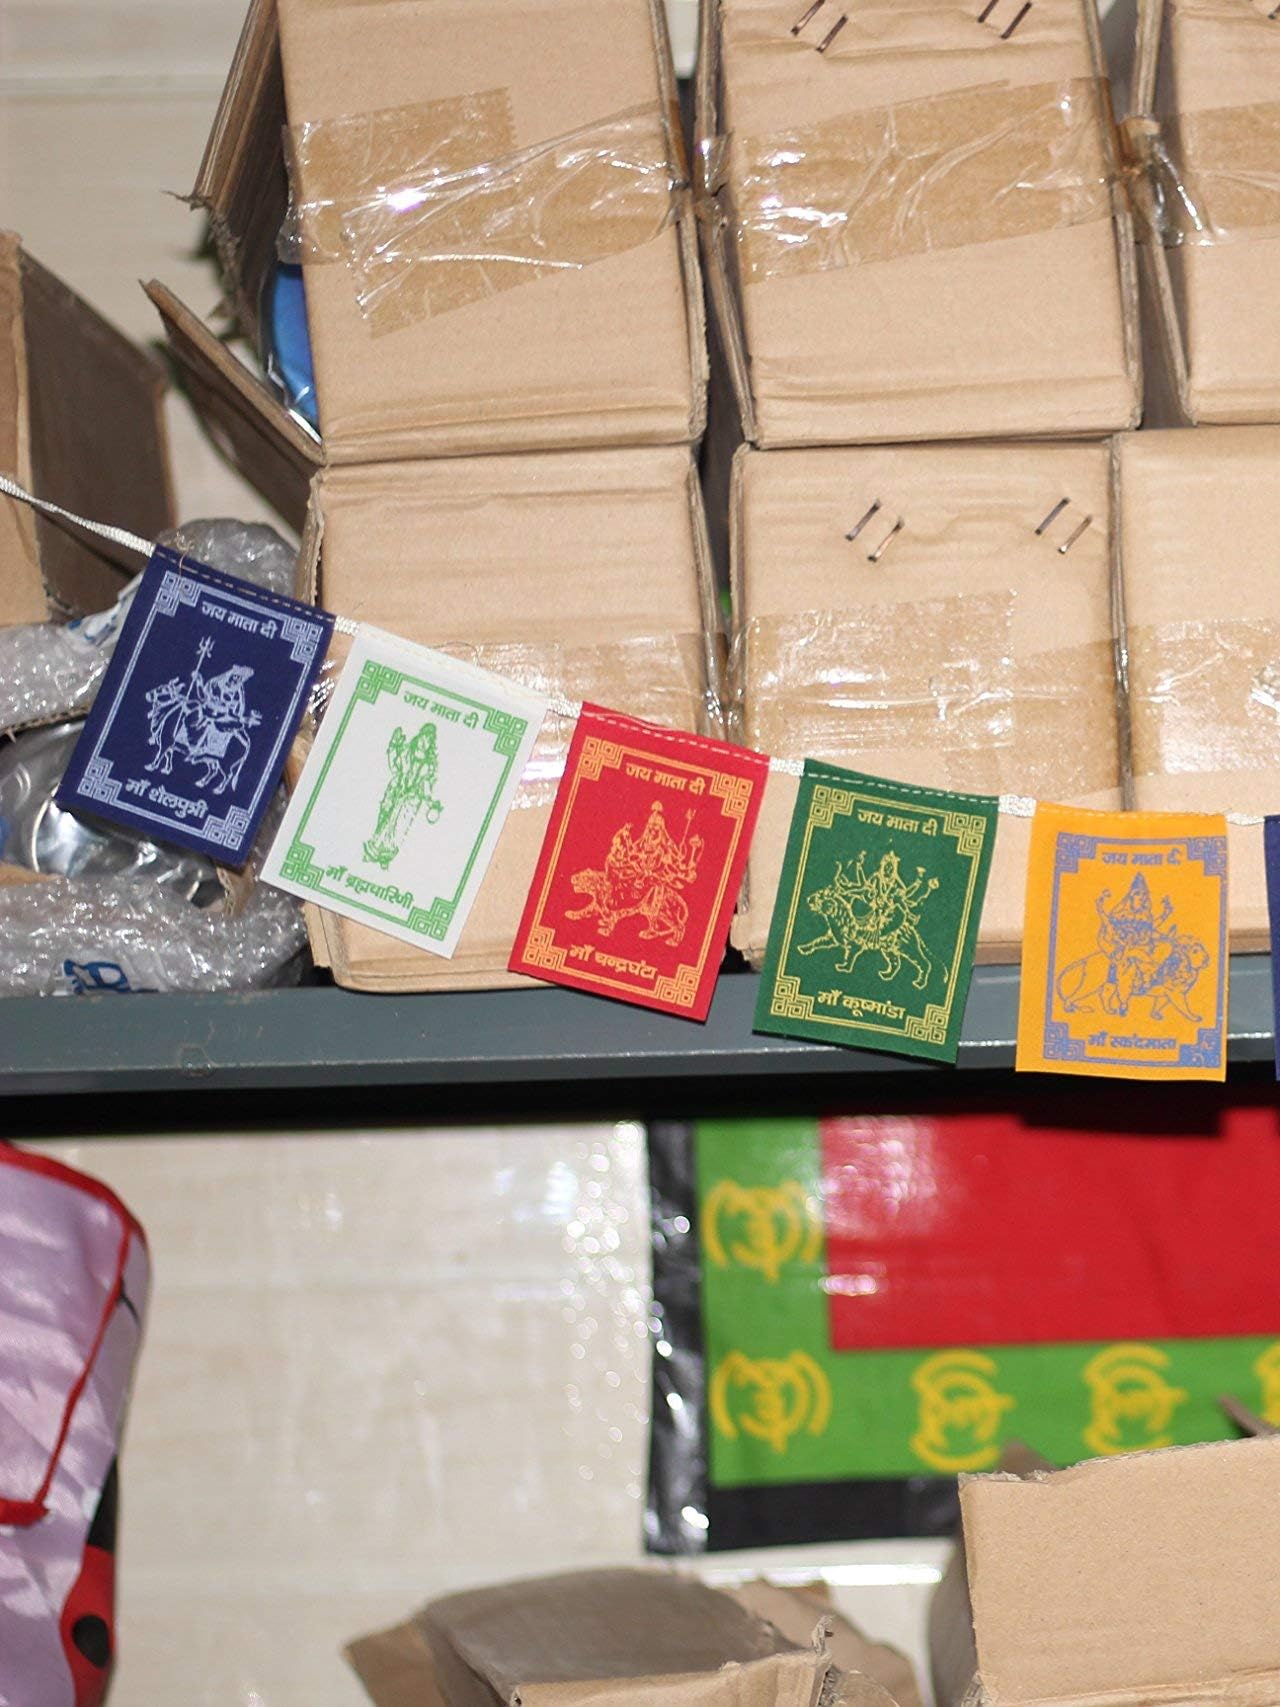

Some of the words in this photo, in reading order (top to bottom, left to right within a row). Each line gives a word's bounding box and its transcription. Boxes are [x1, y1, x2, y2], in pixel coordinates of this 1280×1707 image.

[202, 601, 227, 621] जय
[228, 611, 259, 633] माता
[261, 620, 278, 639] दी
[404, 690, 429, 710] जय
[430, 701, 461, 723] माता
[463, 711, 479, 729] दी
[626, 762, 653, 781] जय
[654, 770, 688, 791] माता
[689, 777, 706, 795] दी
[857, 809, 884, 826] जय
[886, 815, 919, 833] माता
[922, 818, 938, 837] दी
[569, 944, 595, 961] माँ
[817, 989, 842, 1006] माँ
